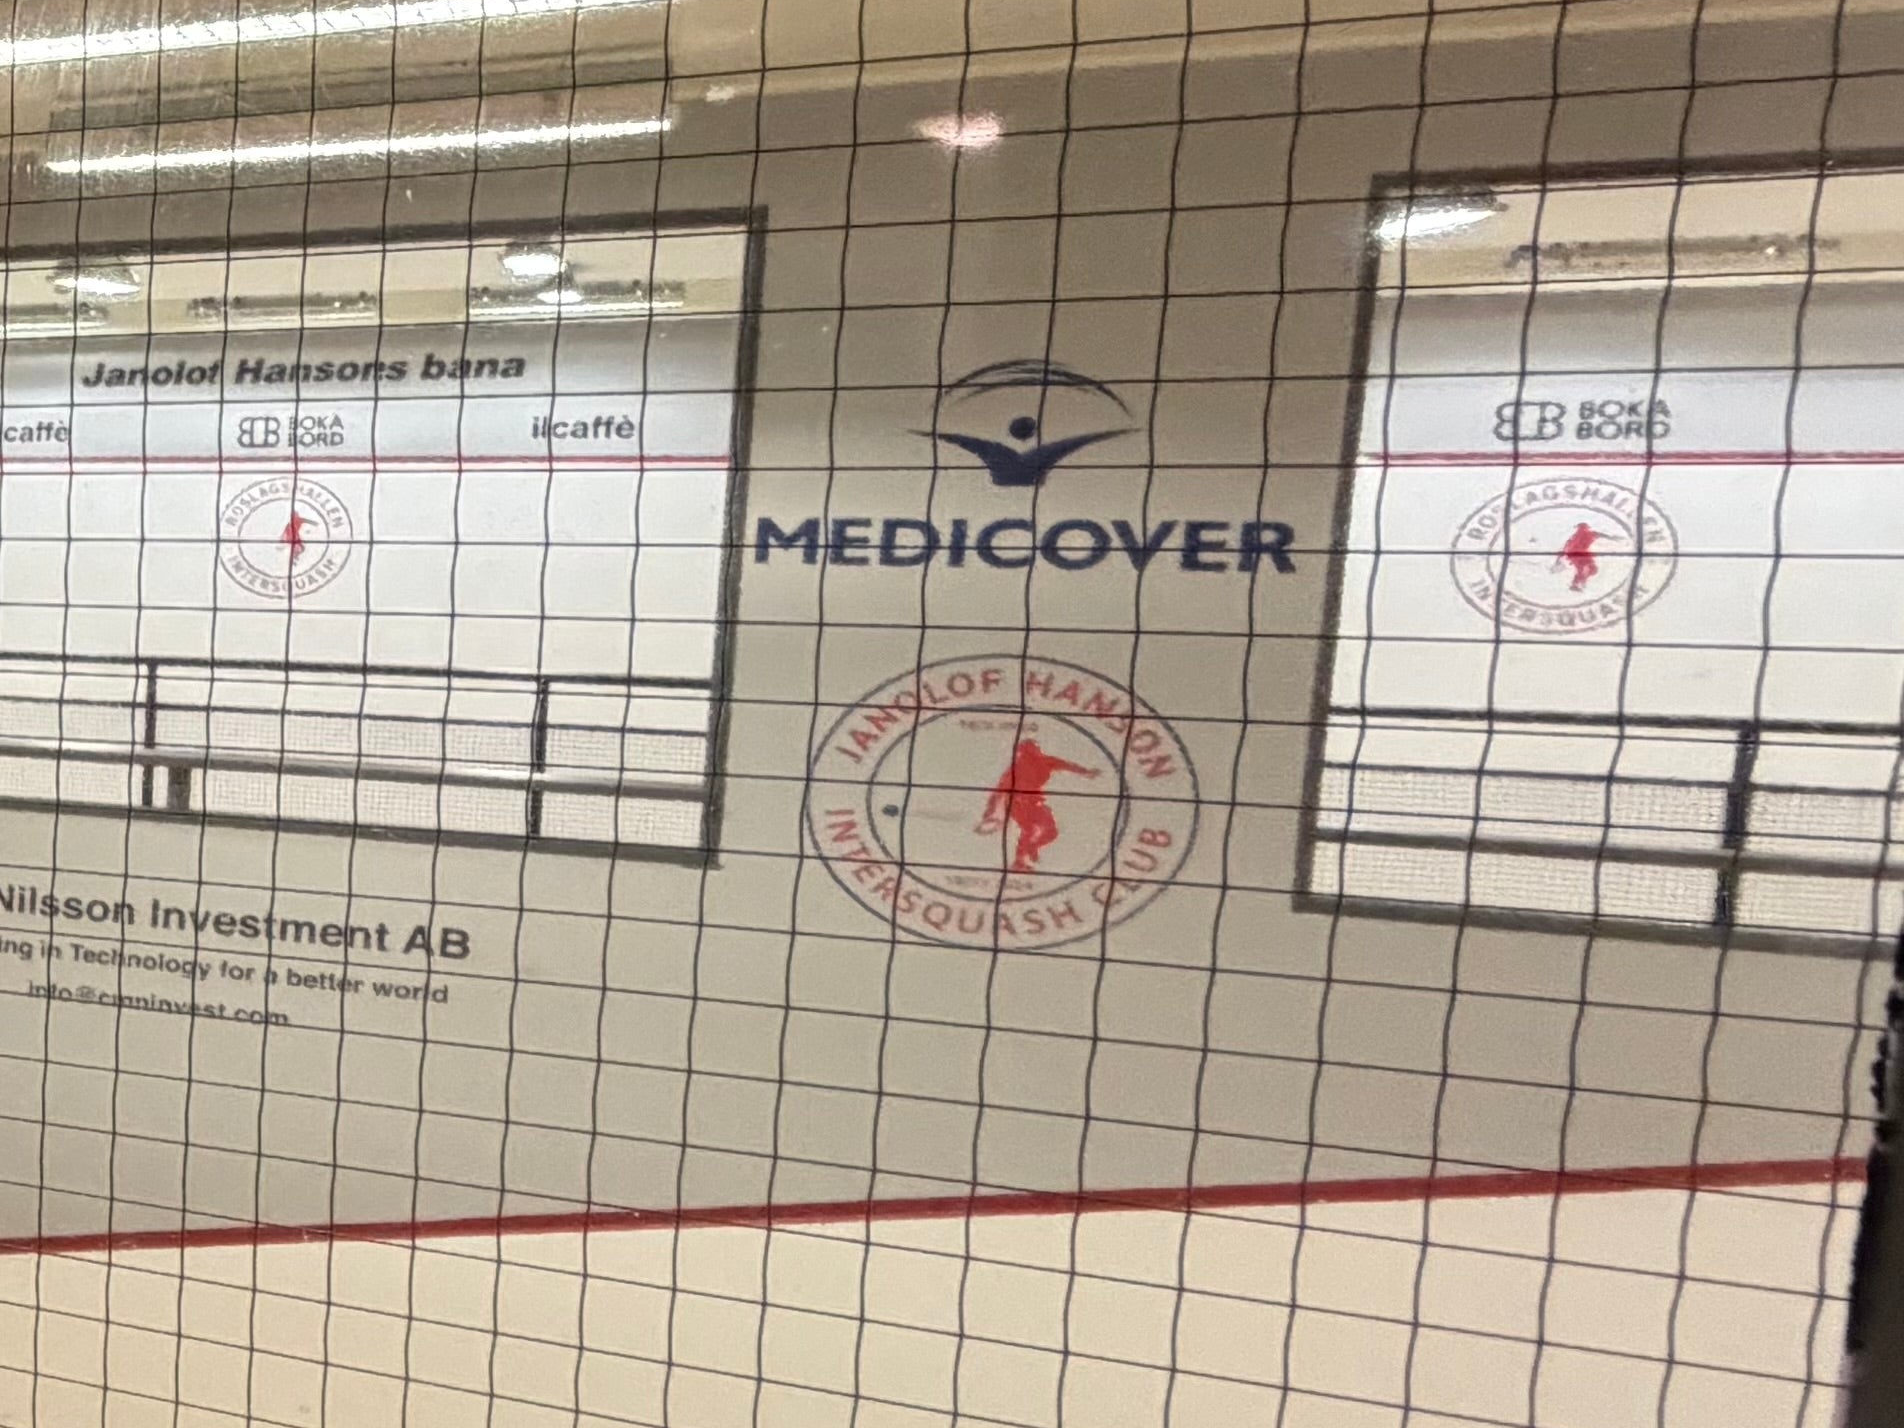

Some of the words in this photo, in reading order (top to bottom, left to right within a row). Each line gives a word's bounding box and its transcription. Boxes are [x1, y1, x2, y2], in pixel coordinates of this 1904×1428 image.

[235, 357, 407, 385] Hansons
[420, 354, 526, 381] bana
[288, 414, 344, 431] BOKA
[1576, 421, 1671, 440] BORD
[1578, 399, 1672, 421] BOKA
[288, 431, 344, 448] BORD
[754, 517, 1297, 574] MEDICOVER
[834, 668, 1003, 764] JANOLOF
[1024, 669, 1178, 779] HANSON
[824, 807, 1085, 937] INTERSQUASH
[1091, 826, 1175, 909] CLUB
[150, 897, 390, 952] Investment
[402, 923, 471, 960] AB
[40, 941, 62, 959] in
[70, 943, 213, 982] Technology
[220, 959, 256, 981] for
[264, 970, 278, 986] a
[286, 967, 365, 994] better
[372, 983, 449, 1004] world
